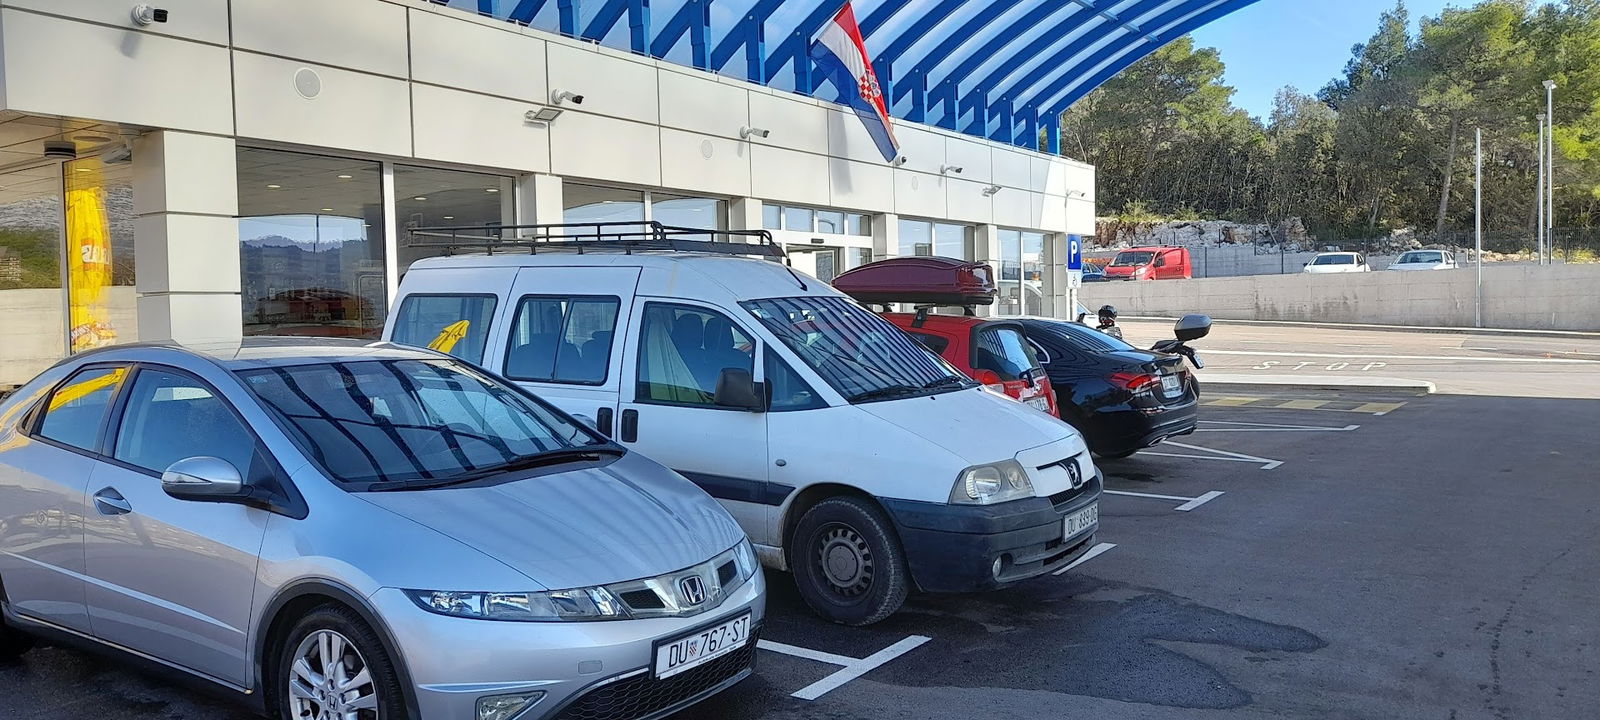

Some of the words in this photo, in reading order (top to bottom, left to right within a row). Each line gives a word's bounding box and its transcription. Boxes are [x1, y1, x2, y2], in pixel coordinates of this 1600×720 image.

[1070, 240, 1078, 264] P
[1252, 361, 1387, 371] STOP
[668, 640, 689, 668] DU
[699, 616, 749, 657] 767-ST
